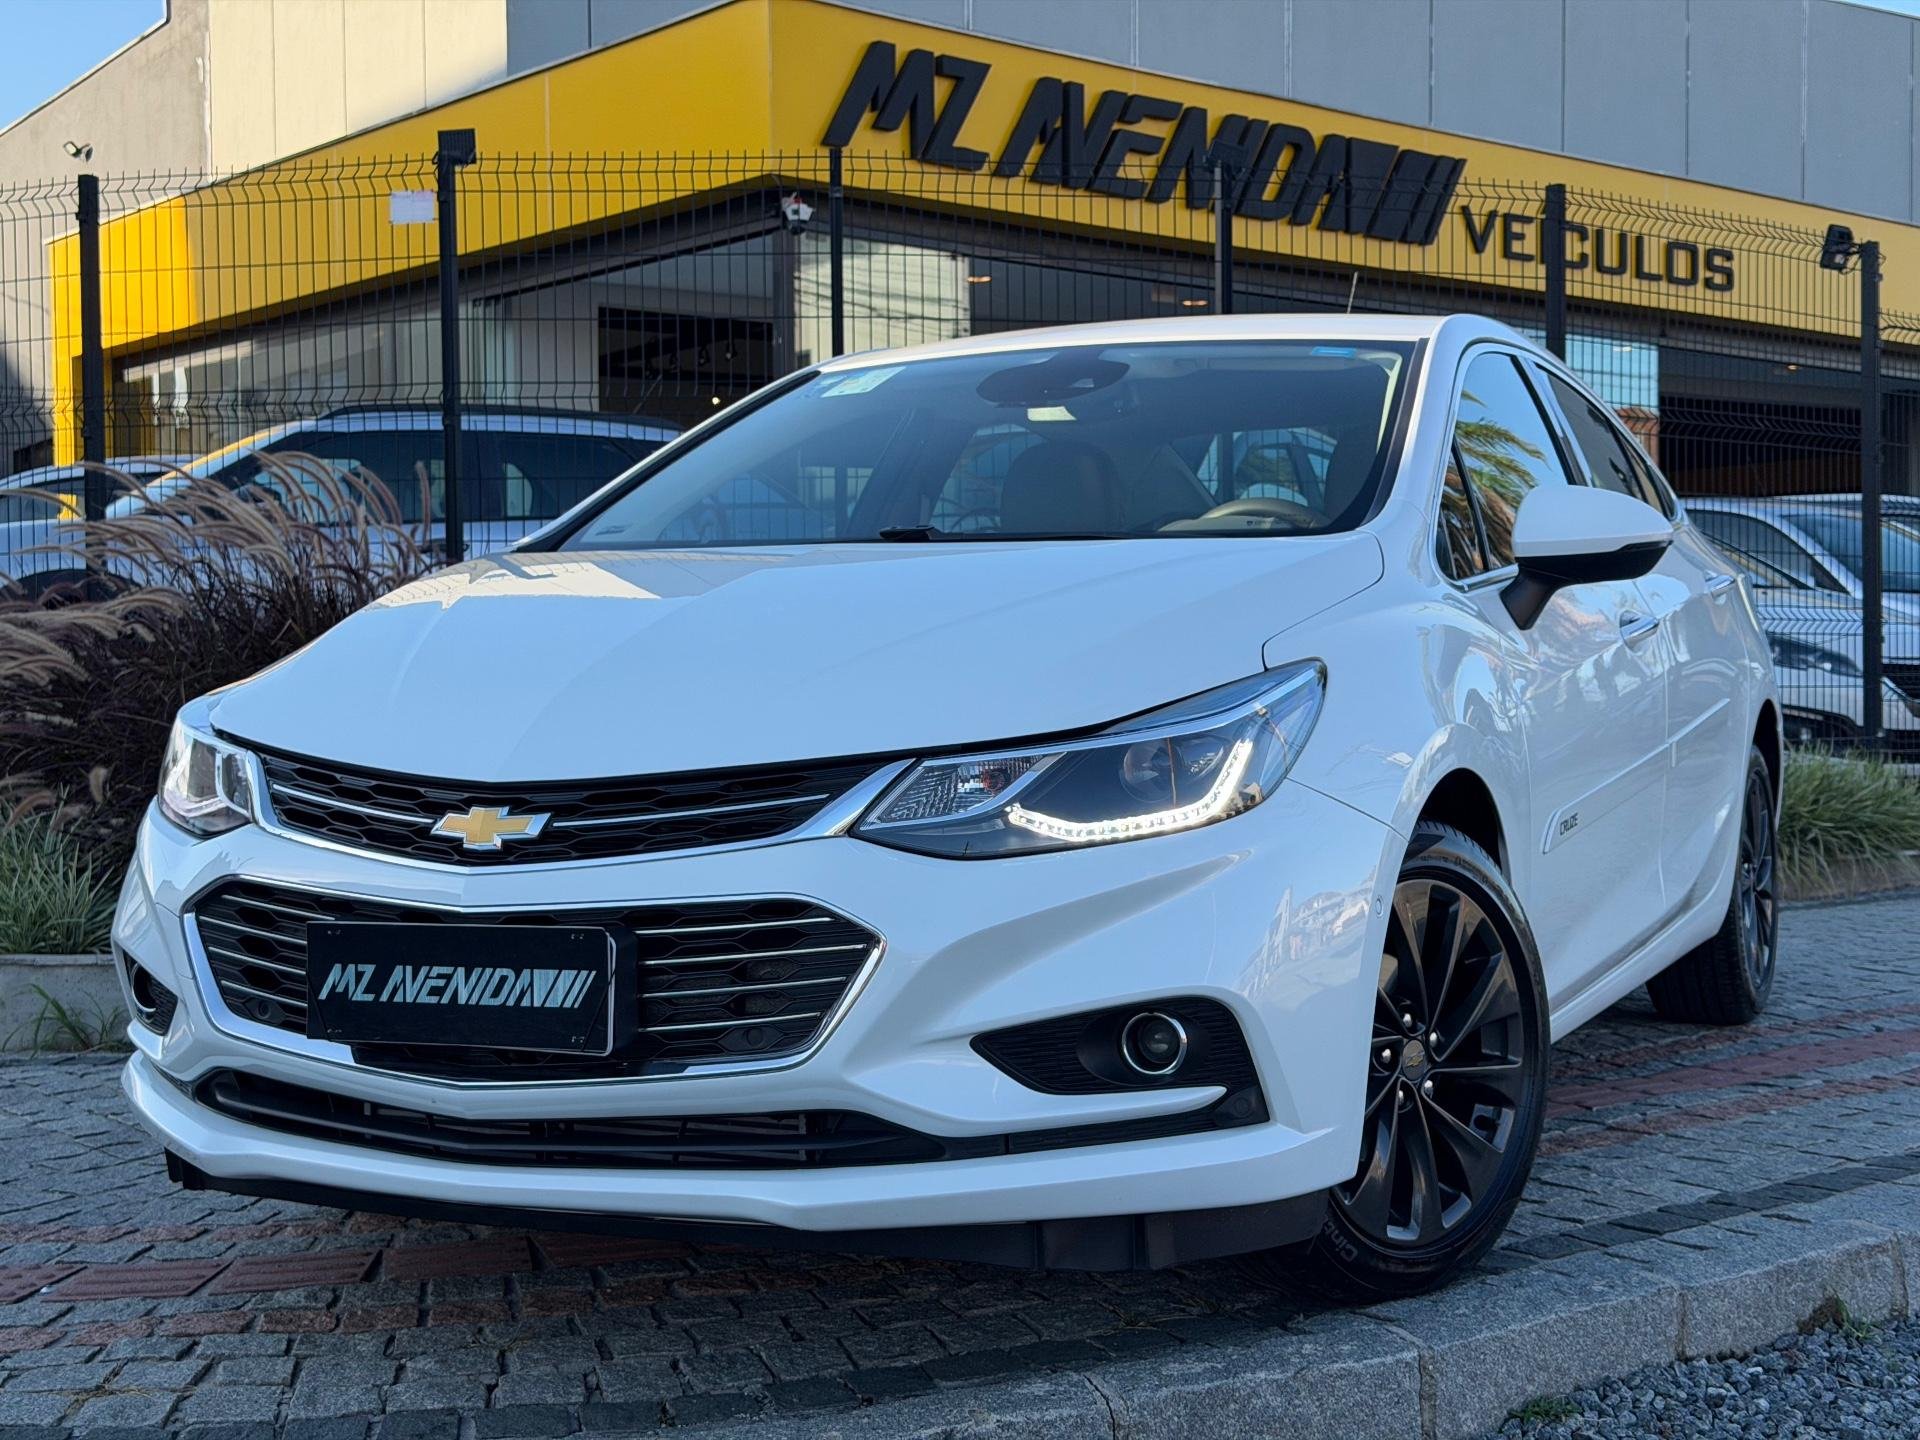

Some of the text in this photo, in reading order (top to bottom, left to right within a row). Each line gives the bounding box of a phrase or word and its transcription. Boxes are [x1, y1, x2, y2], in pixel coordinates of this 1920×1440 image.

[822, 40, 1405, 236] MZ AVENIDA
[1560, 812, 1579, 836] CRUZE
[318, 963, 562, 1008] MZ AVENIDA
